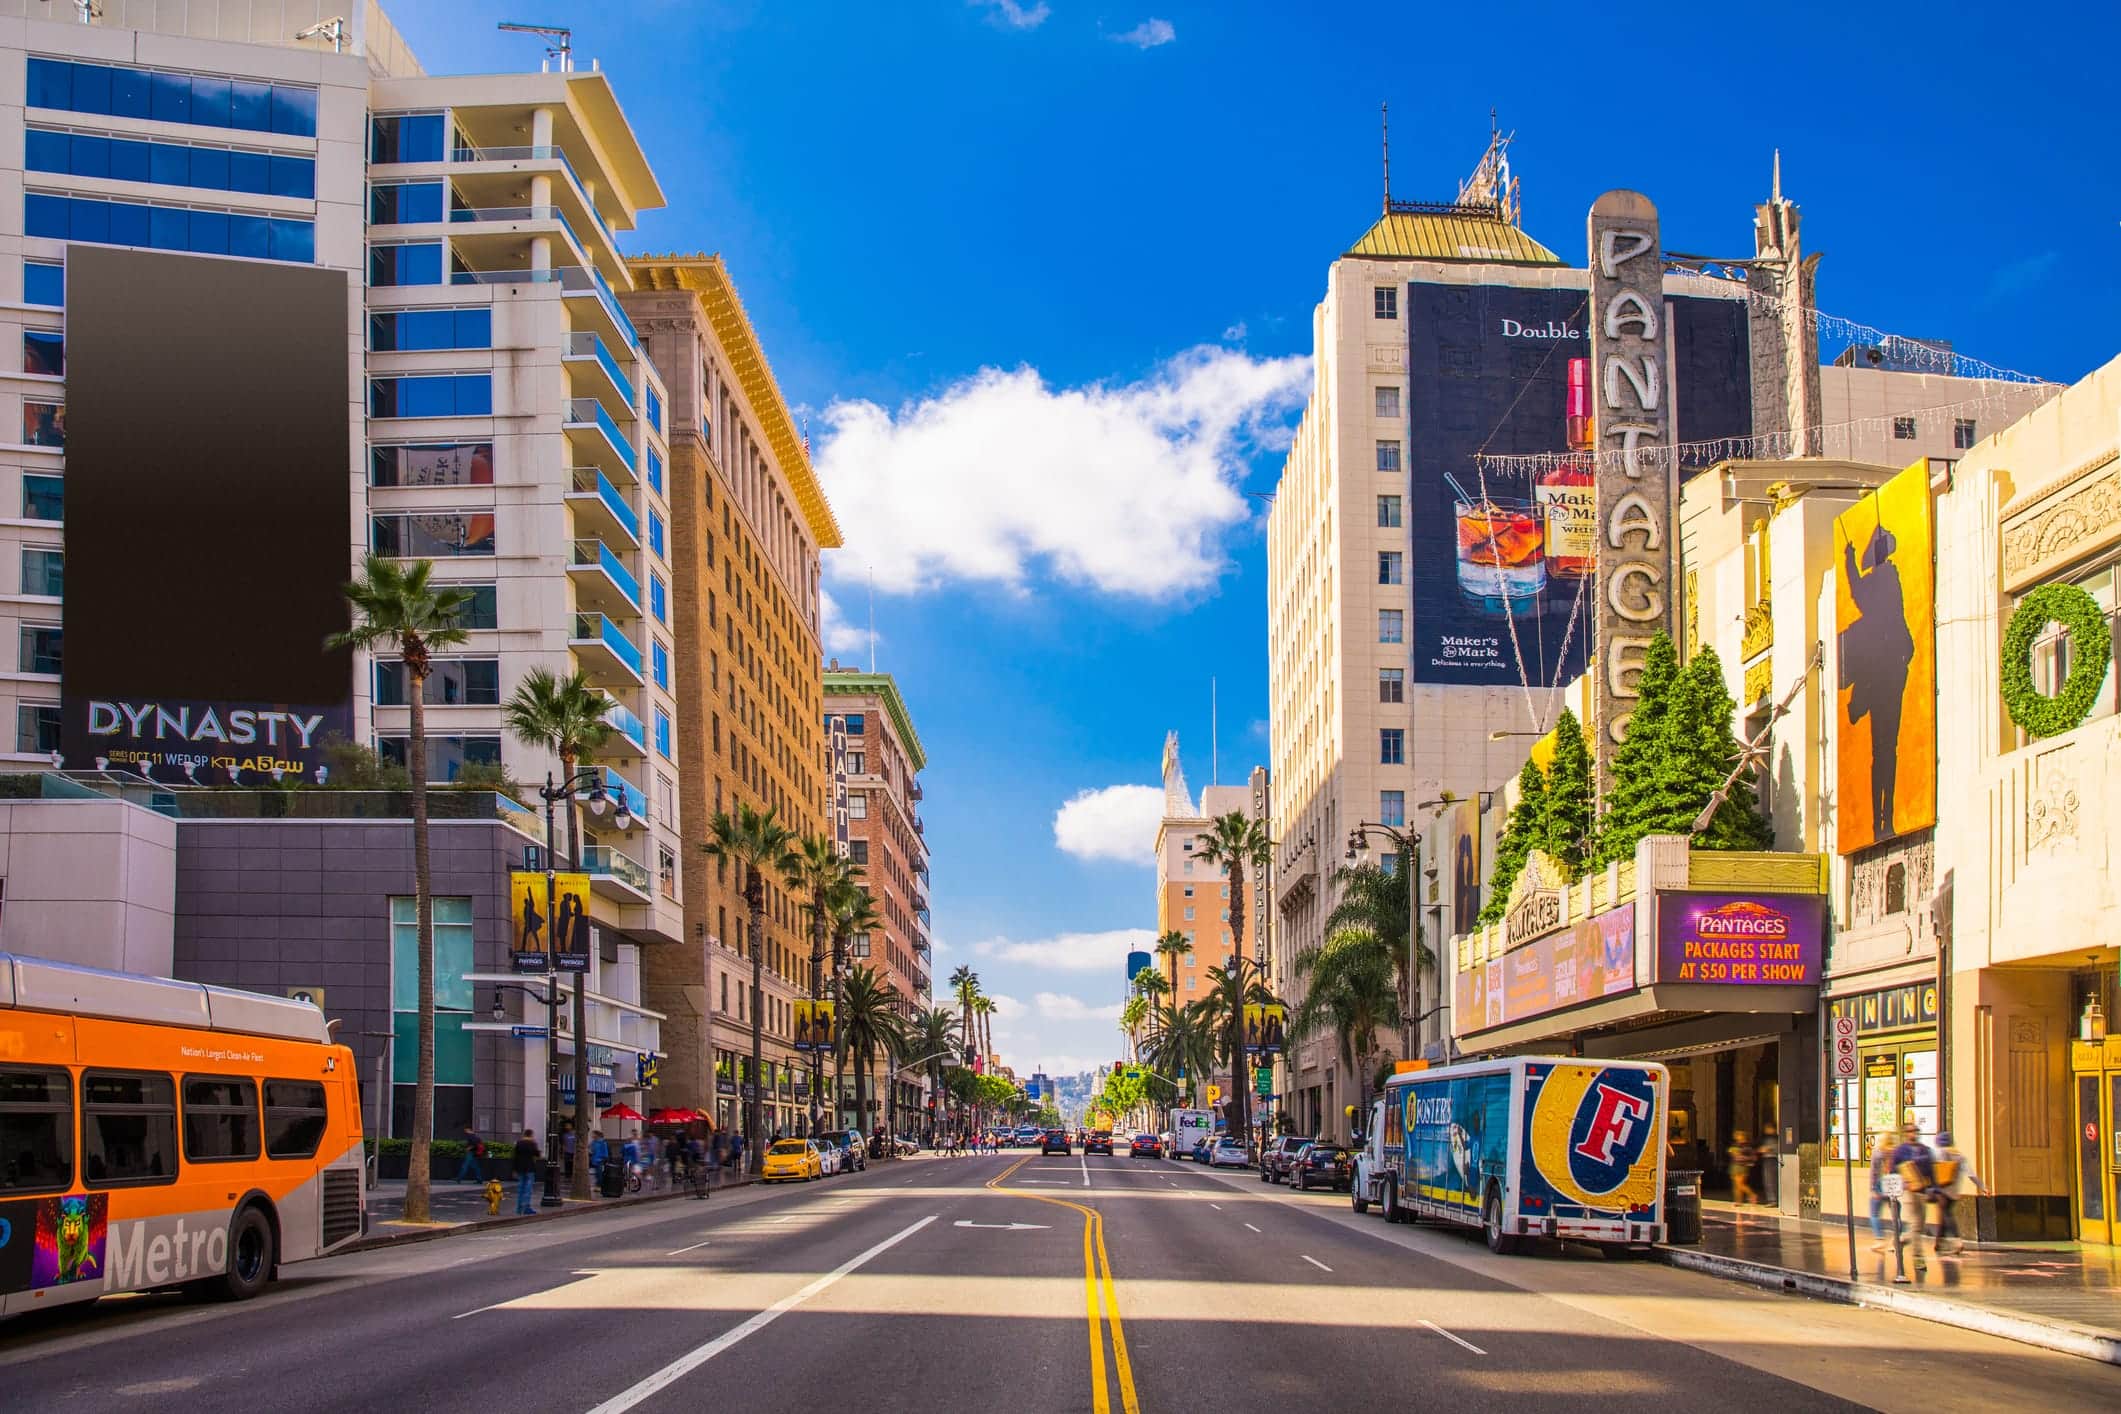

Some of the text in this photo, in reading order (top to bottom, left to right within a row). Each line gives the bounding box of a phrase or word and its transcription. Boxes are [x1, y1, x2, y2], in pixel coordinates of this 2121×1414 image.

[1501, 319, 1580, 339] Double
[1441, 636, 1499, 646] Maker's
[1458, 646, 1499, 657] Mark
[1431, 658, 1462, 667] Delicious
[88, 701, 324, 748] DYNASTY
[129, 752, 150, 765] OCT
[152, 753, 163, 766] 11
[165, 754, 192, 767] WED
[194, 755, 209, 769] 9P
[834, 731, 847, 826] TAFT
[1700, 916, 1786, 934] PANTAGES
[1684, 941, 1801, 960] PACKAGES START
[1679, 962, 1806, 981] AT $50 PER SHOW
[181, 1046, 204, 1057] Nation's
[206, 1049, 226, 1061] Largest
[251, 1052, 264, 1062] Fleet
[1179, 1116, 1210, 1129] FedEx
[1575, 1083, 1649, 1166] F
[103, 1218, 227, 1291] Metro
